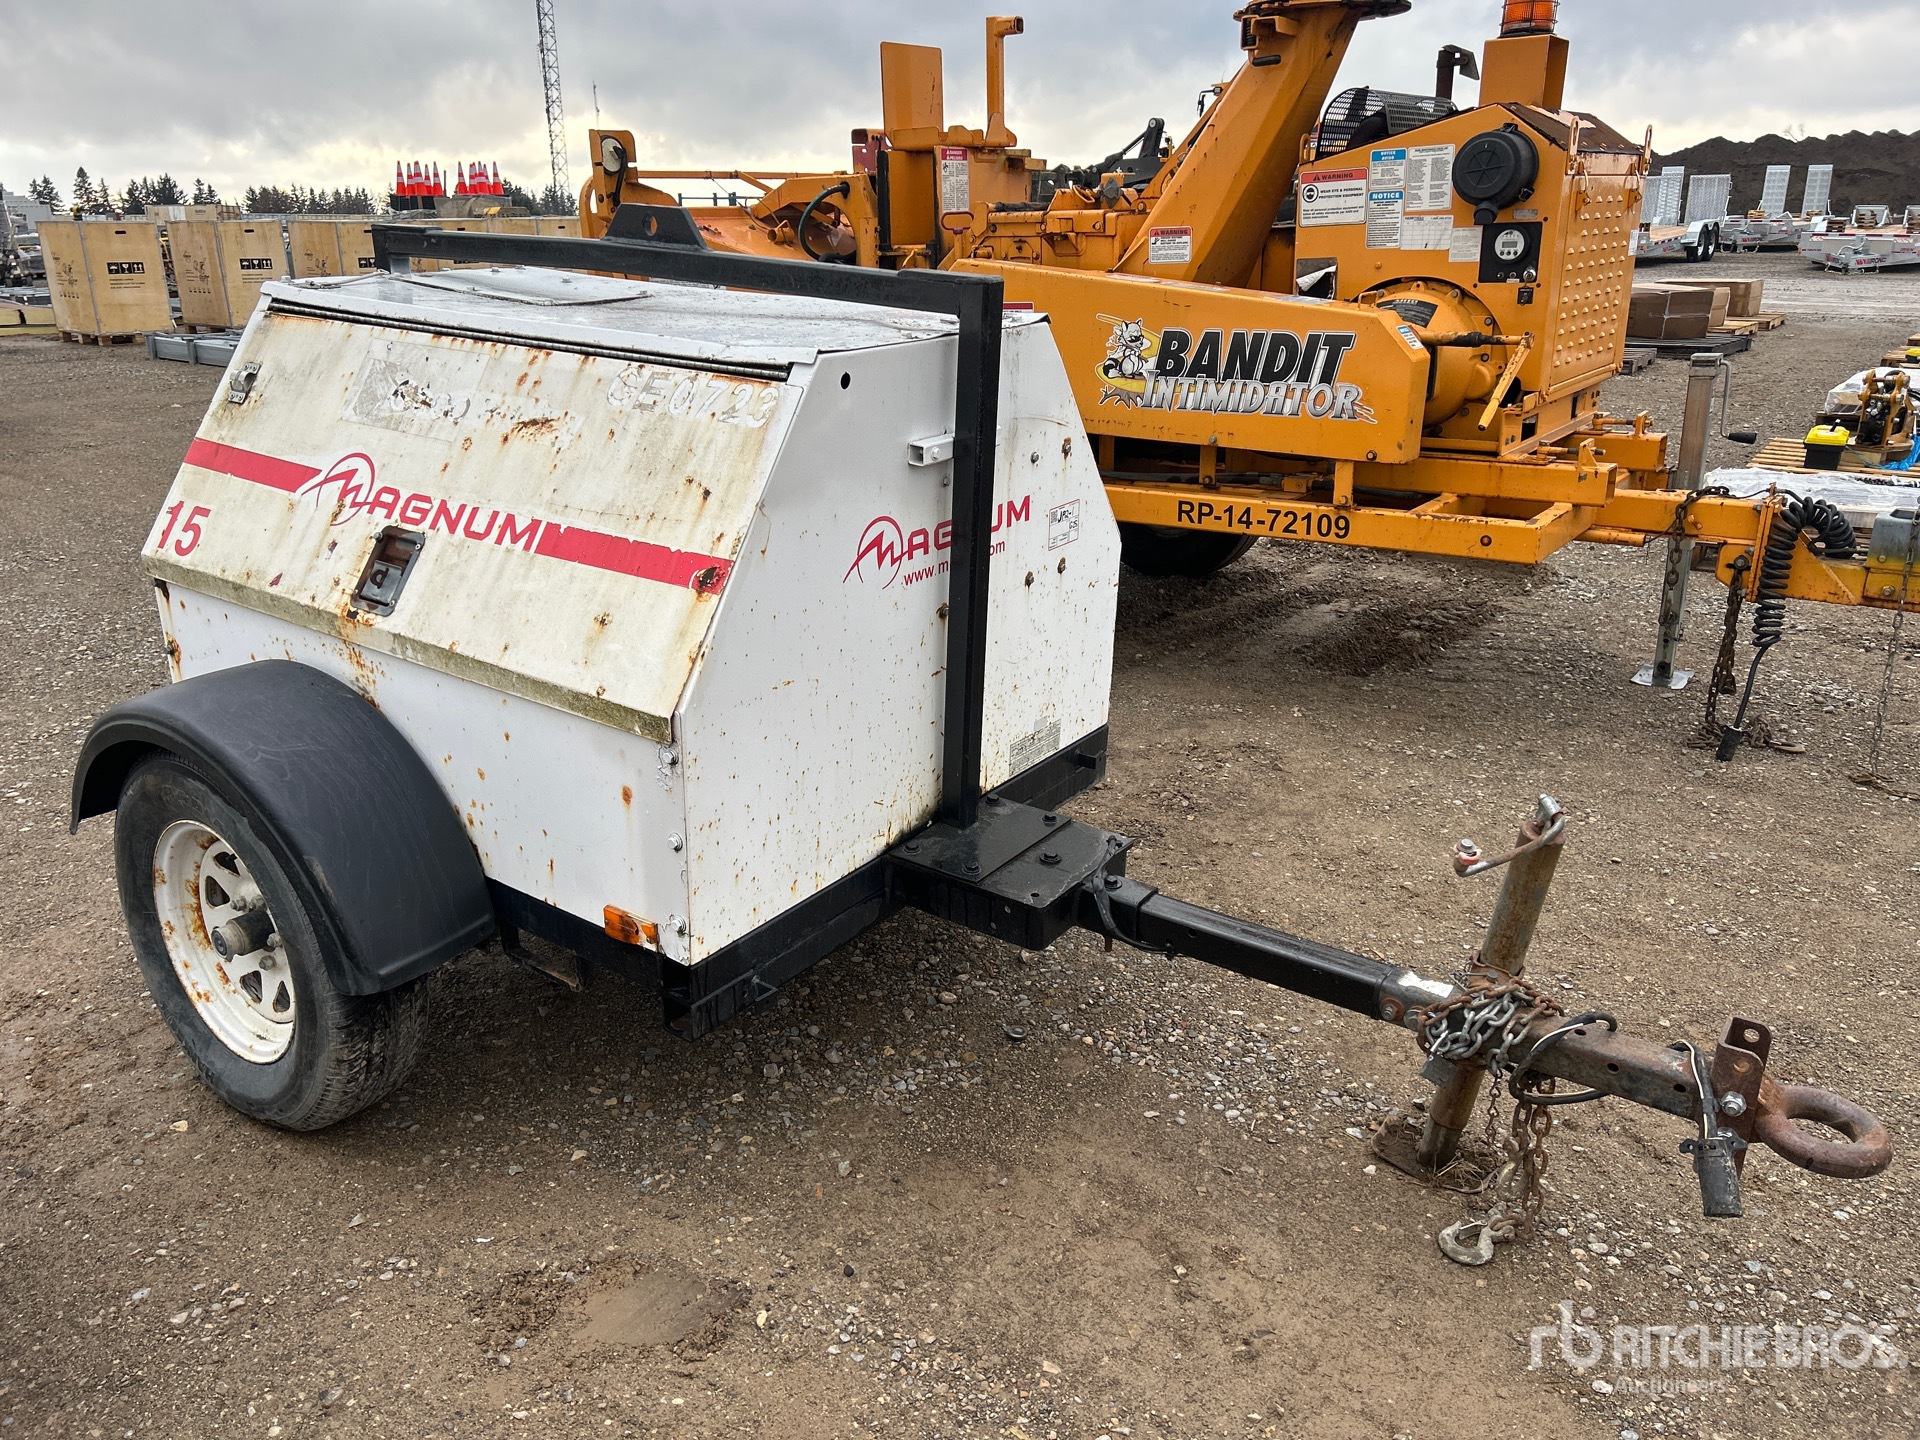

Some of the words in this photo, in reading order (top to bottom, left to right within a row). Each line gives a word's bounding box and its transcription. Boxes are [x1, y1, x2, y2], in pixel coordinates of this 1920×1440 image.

[1155, 327, 1358, 385] BANDIT
[1138, 369, 1362, 421] INTIMIDATOR
[158, 499, 211, 556] 15
[299, 453, 542, 552] MAGNUM
[1177, 500, 1350, 539] RP-14-72109
